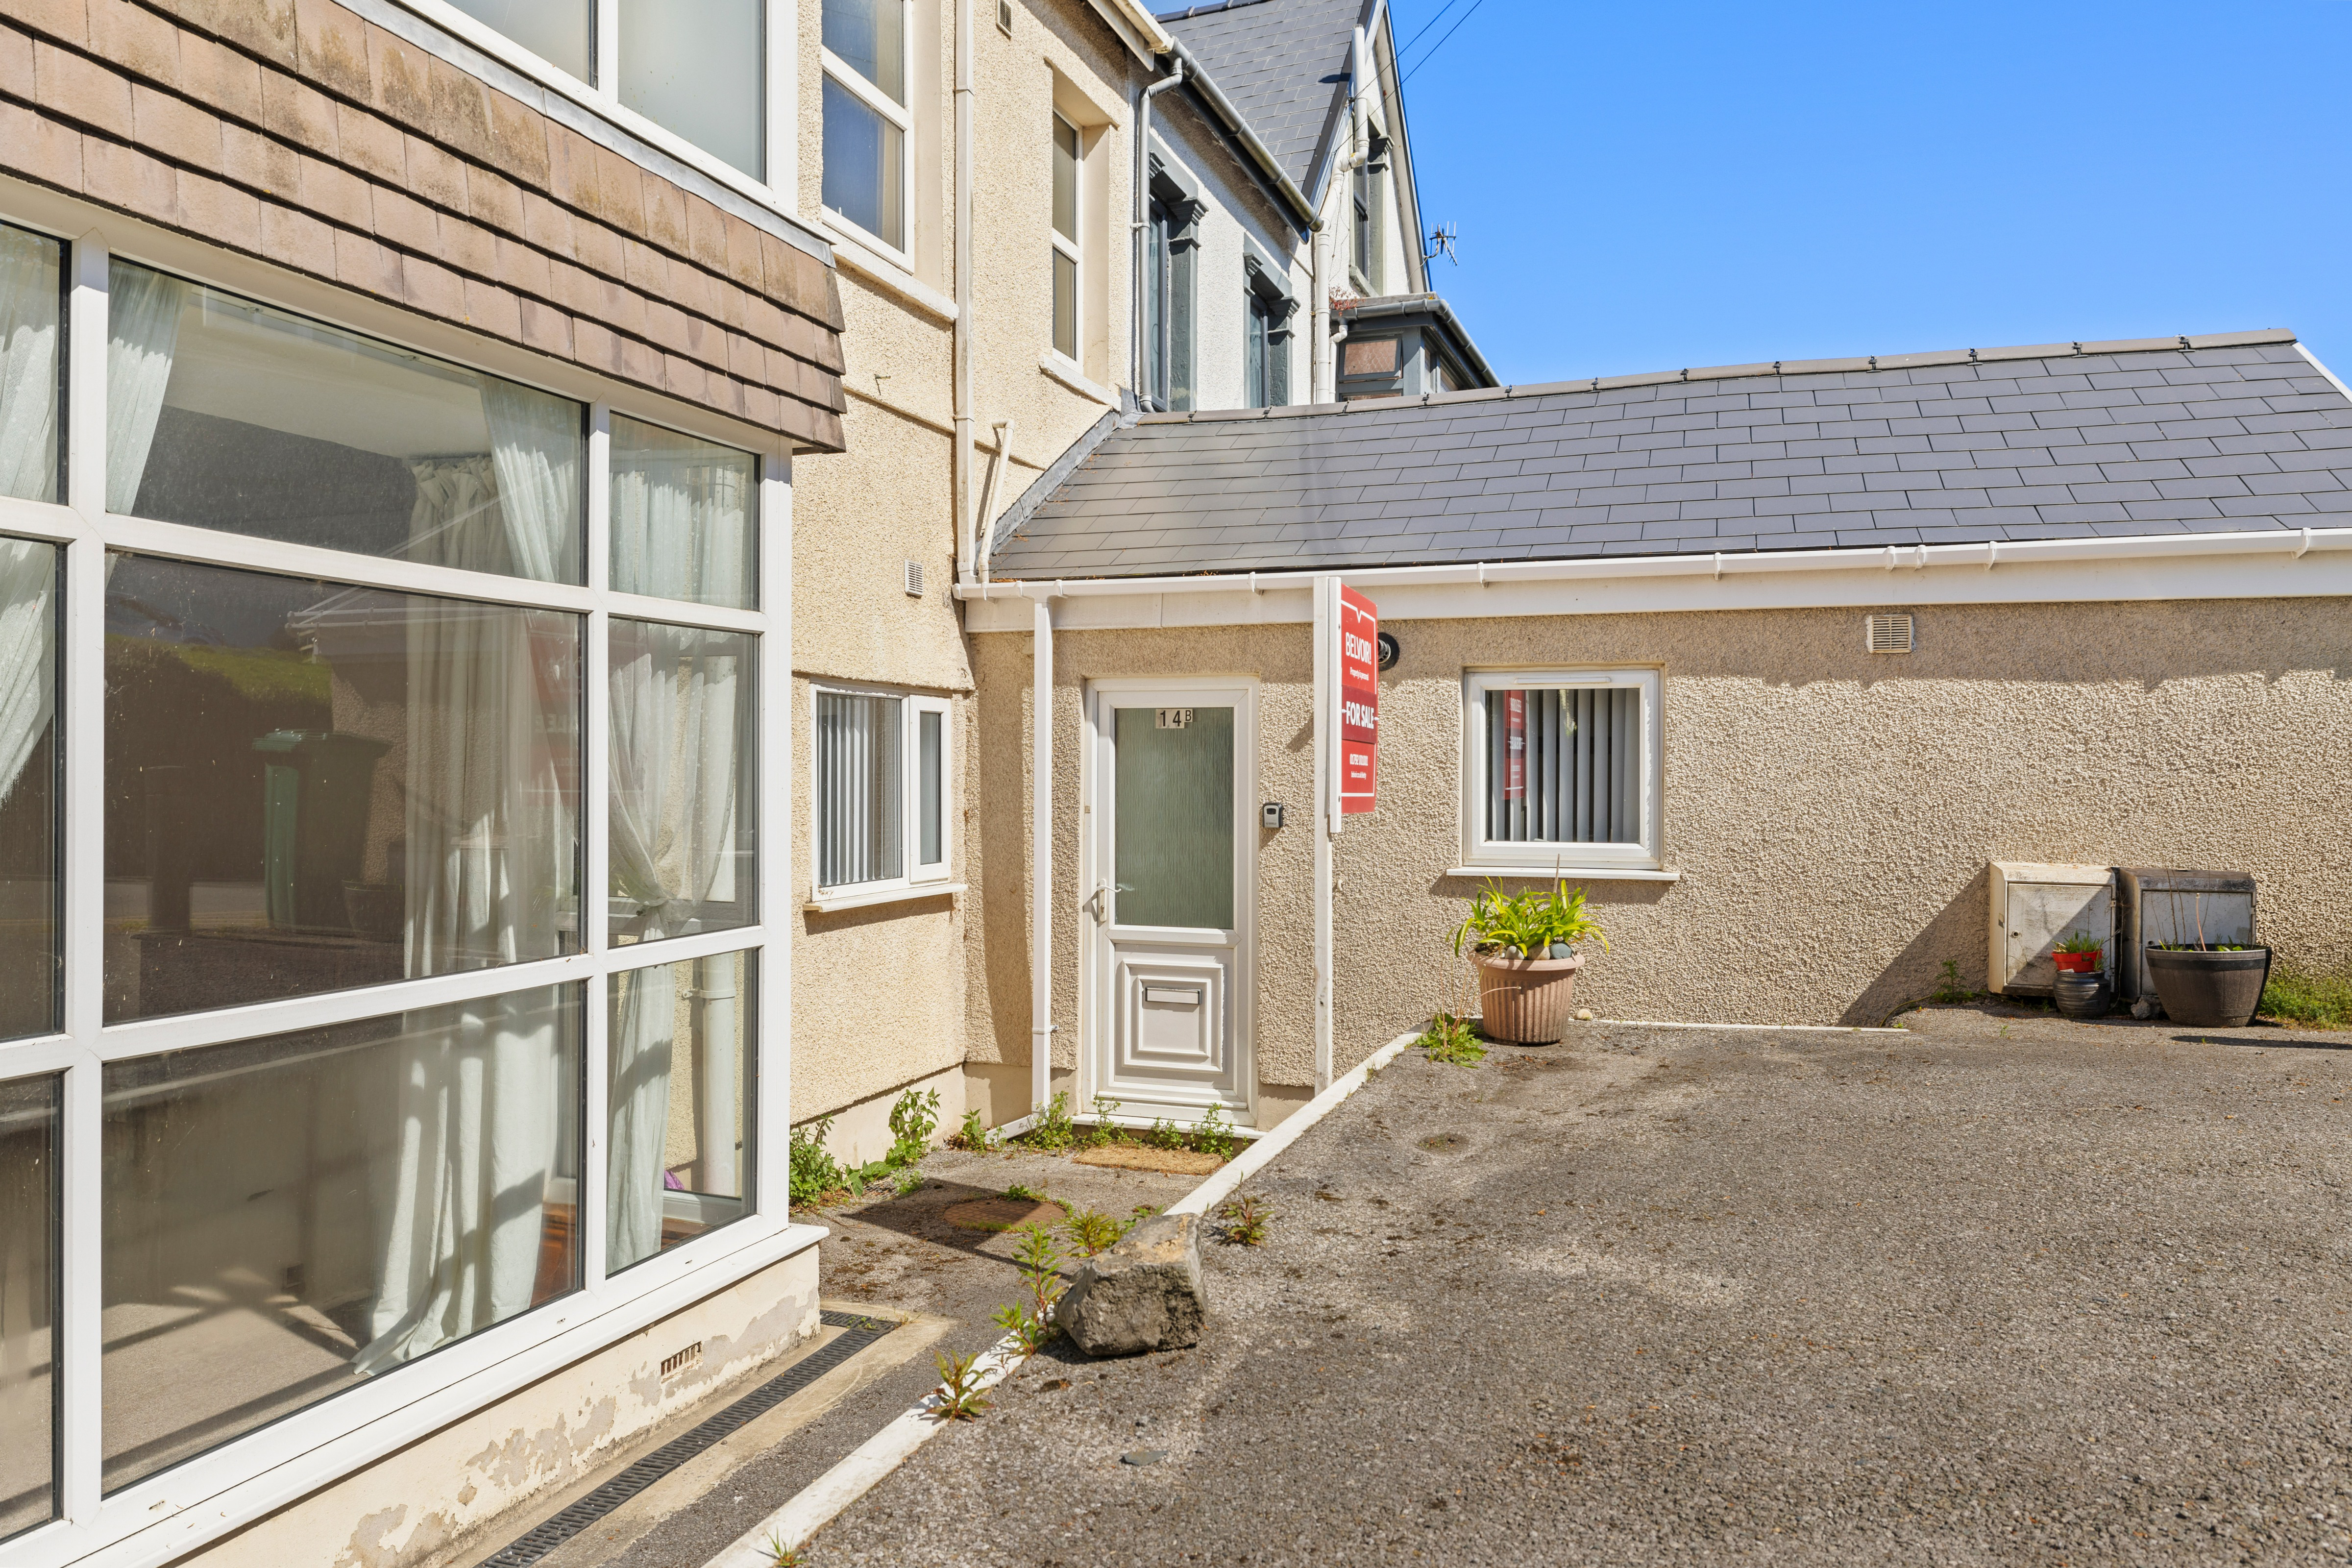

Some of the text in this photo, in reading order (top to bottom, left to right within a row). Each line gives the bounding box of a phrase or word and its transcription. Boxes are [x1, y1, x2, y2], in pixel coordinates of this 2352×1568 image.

[1346, 632, 1372, 665] BELVOIR!
[1346, 701, 1374, 729] FOR SALE
